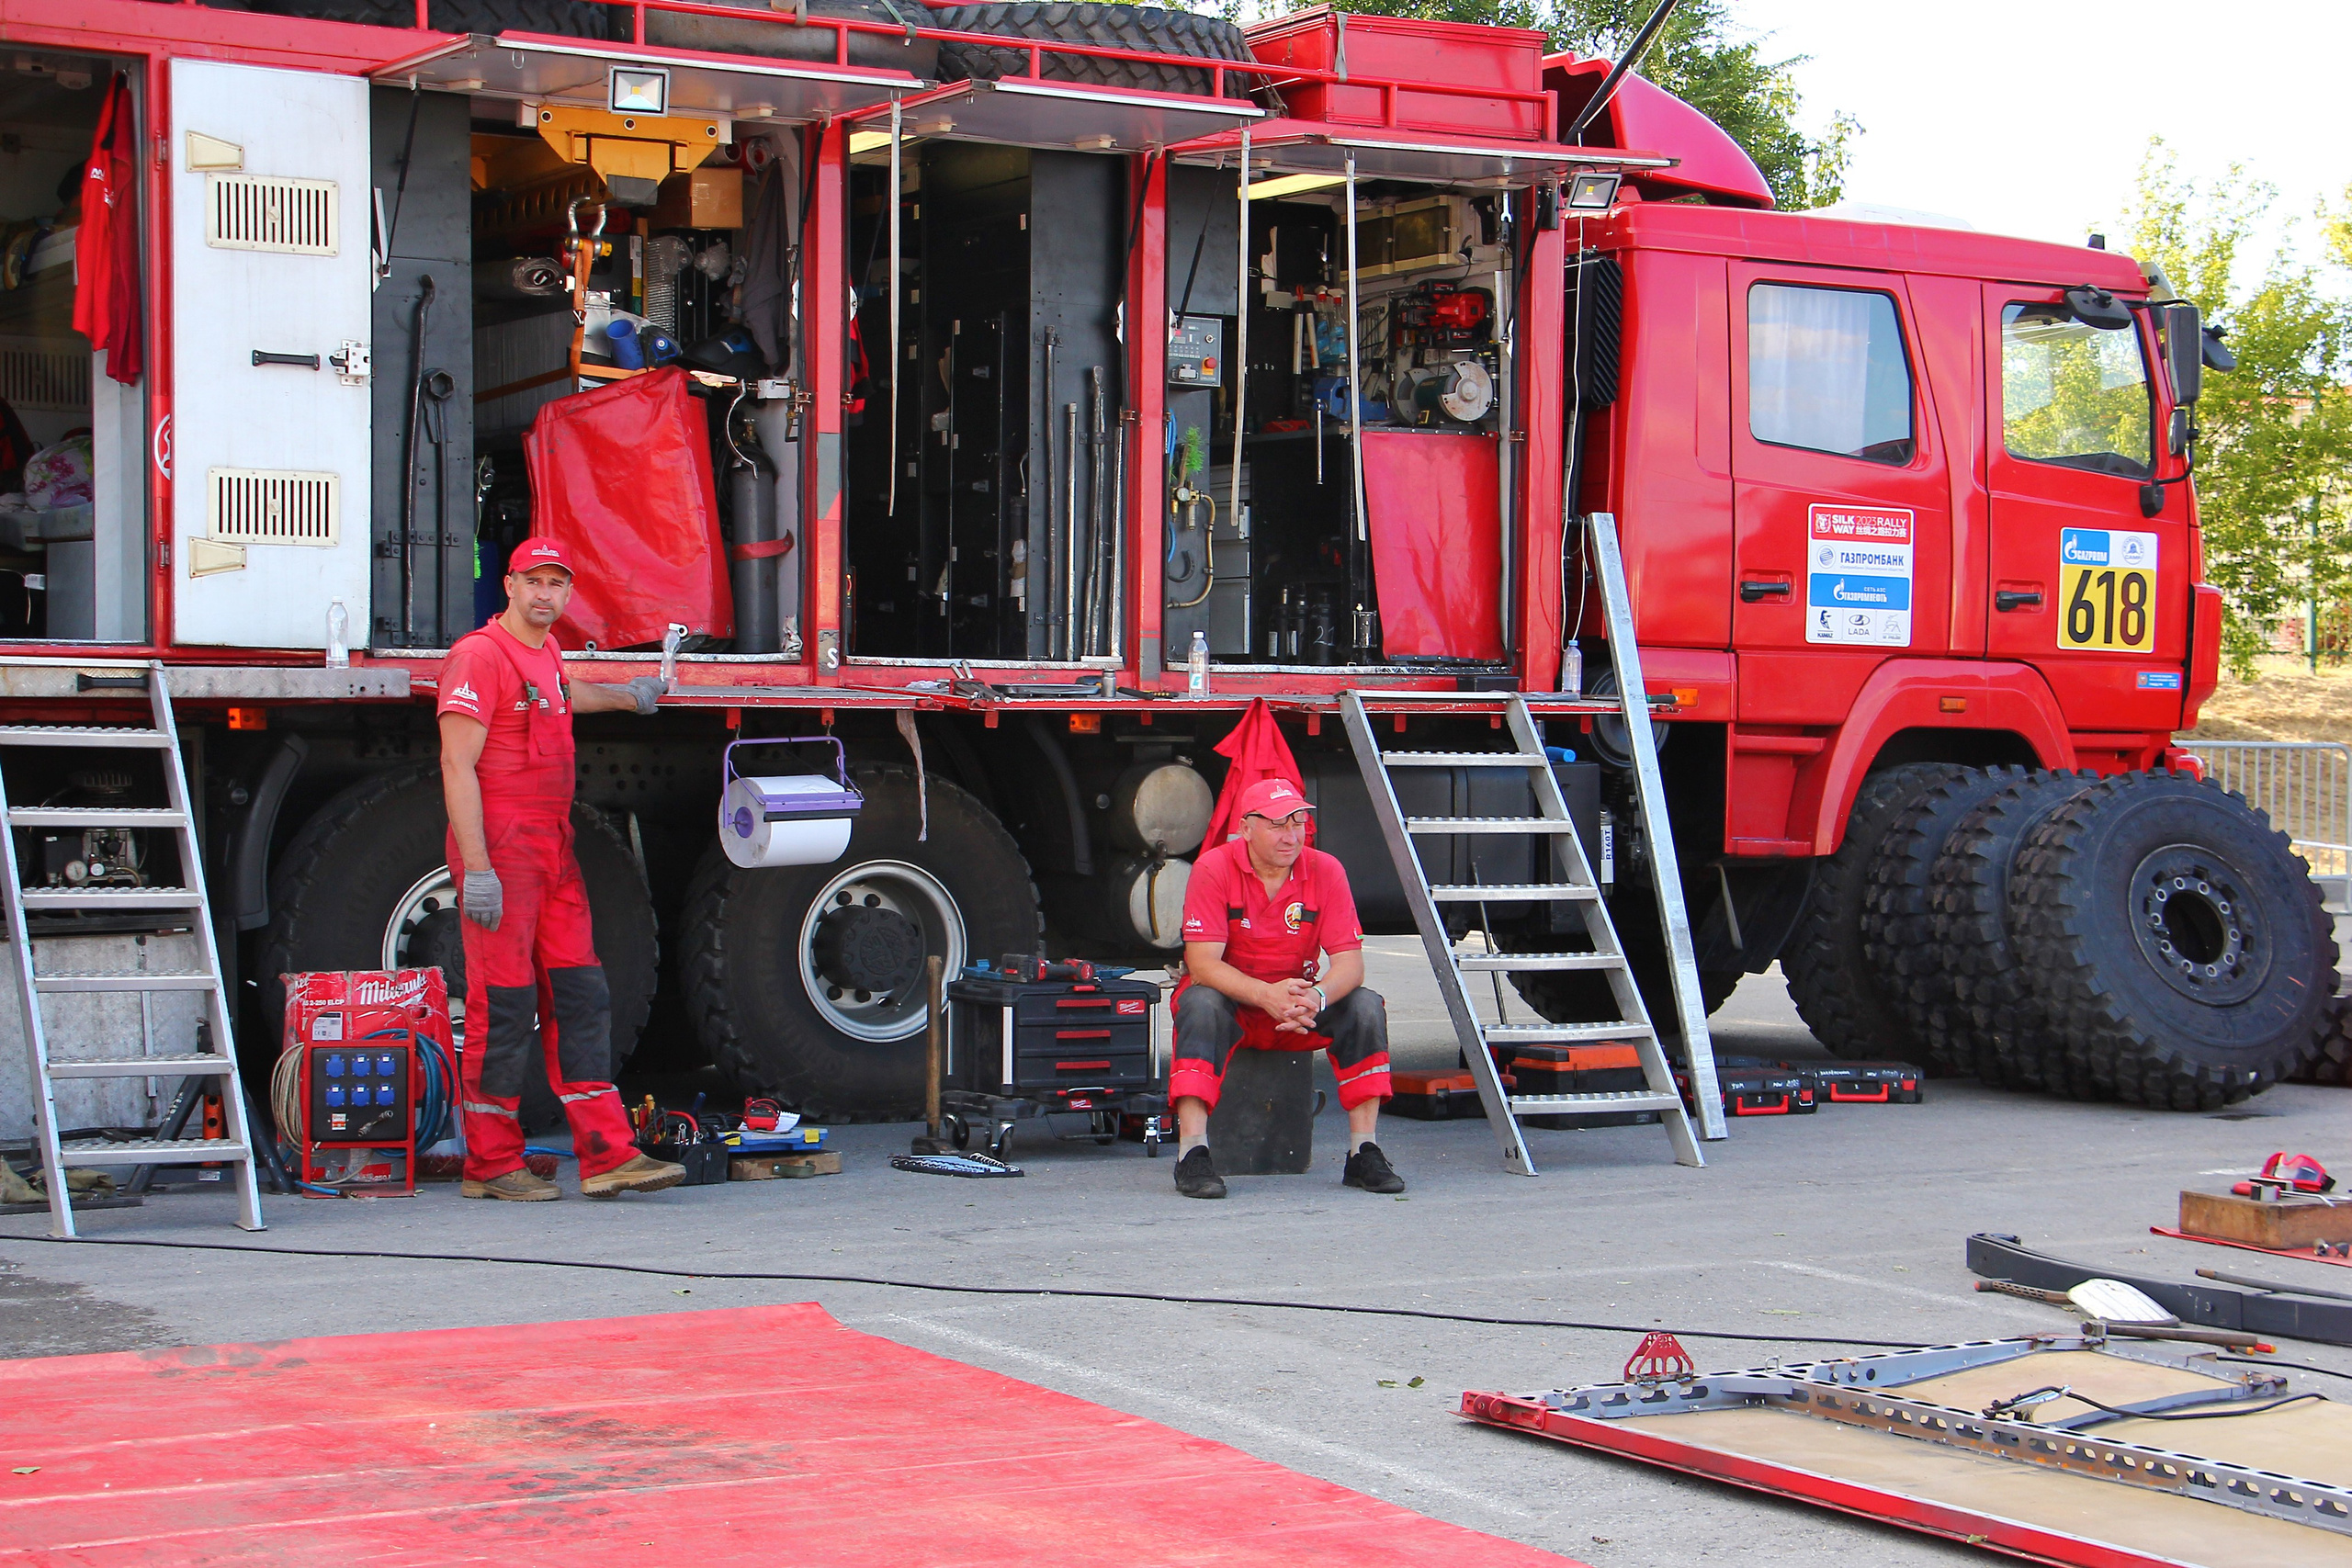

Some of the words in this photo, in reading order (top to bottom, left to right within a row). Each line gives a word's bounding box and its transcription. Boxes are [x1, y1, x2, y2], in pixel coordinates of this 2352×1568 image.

[1831, 514, 1855, 525] SILK
[1856, 515, 1877, 526] 2023
[1877, 517, 1907, 527] RALLY
[1832, 525, 1855, 535] WAY
[1840, 552, 1905, 566] ГАЗПРОМБАНК
[2077, 550, 2108, 562] GAZPROM
[1843, 592, 1888, 603] ГАЗПРОМНЕФТЬ
[2067, 570, 2147, 646] 618
[447, 700, 479, 714] www.maz.by
